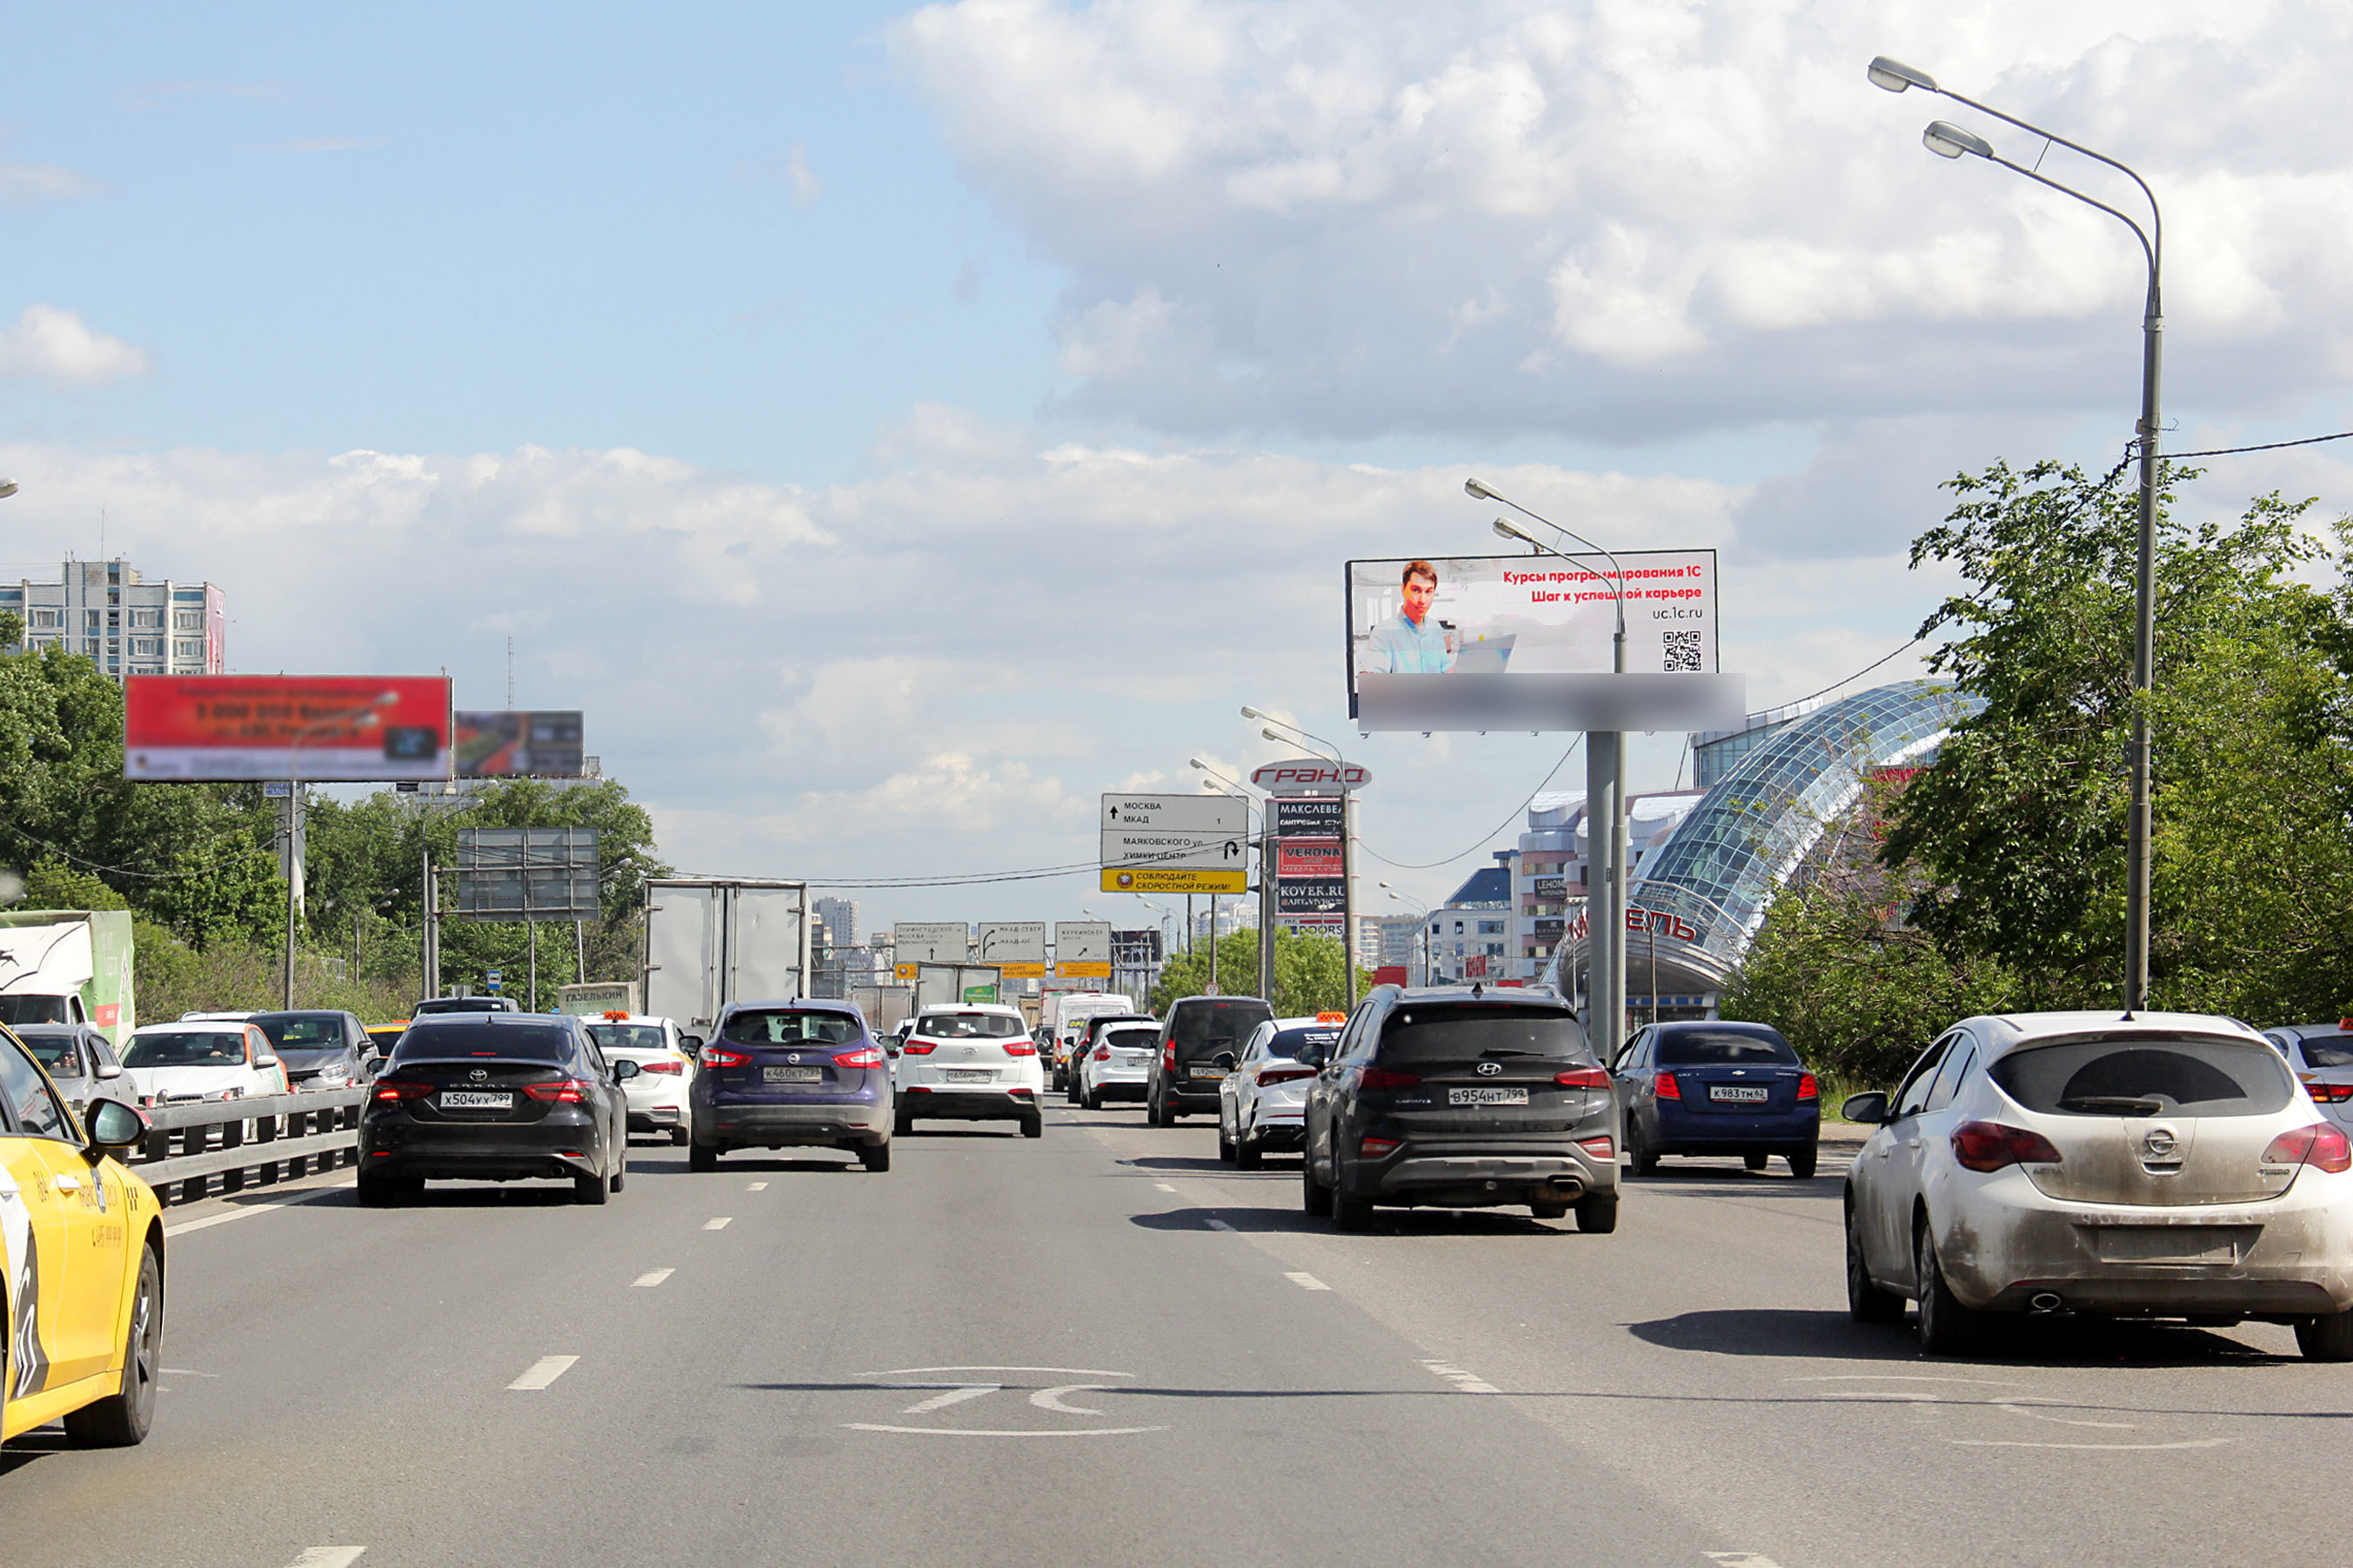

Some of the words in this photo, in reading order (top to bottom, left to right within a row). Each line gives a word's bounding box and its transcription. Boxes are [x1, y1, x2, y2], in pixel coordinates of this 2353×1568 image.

[1503, 571, 1546, 584] Курсы
[1532, 591, 1561, 603] Шаг
[1564, 593, 1571, 602] к
[1645, 588, 1701, 600] карьере
[1653, 606, 1702, 619] uc.1c.ru
[1124, 802, 1161, 811] МОСКВА
[1124, 816, 1149, 824] МКАД
[1123, 837, 1191, 846] МАЯКОВСКОГО
[1287, 848, 1342, 857] VERONA
[1136, 872, 1197, 881] СОБЛЮДАЙТЕ
[566, 991, 623, 1003] ГАЗЕЛЬКИН
[492, 1093, 510, 1103] 799
[1506, 1089, 1525, 1099] 799
